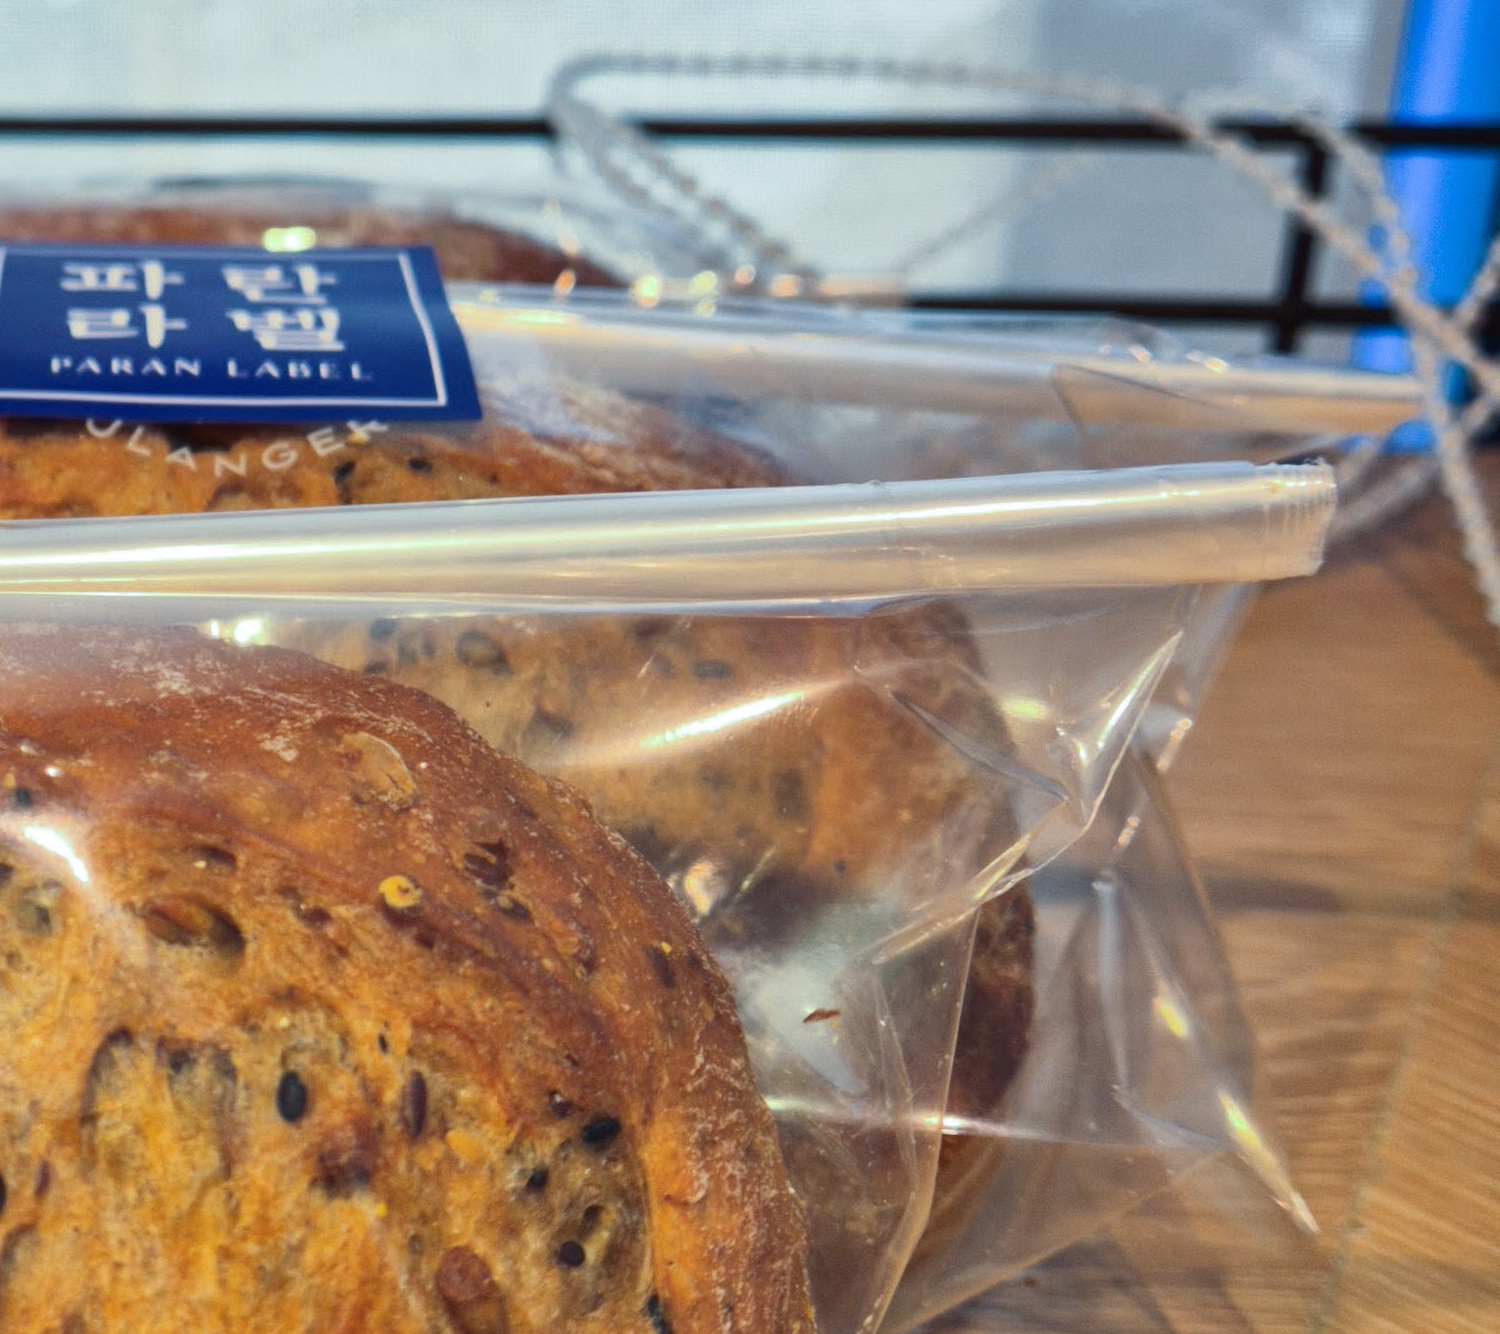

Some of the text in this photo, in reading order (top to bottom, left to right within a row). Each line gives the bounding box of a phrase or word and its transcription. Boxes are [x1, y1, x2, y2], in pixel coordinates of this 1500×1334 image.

[60, 260, 338, 305] 파란
[66, 302, 346, 352] 라벨
[50, 355, 374, 381] PARAN LABEL
